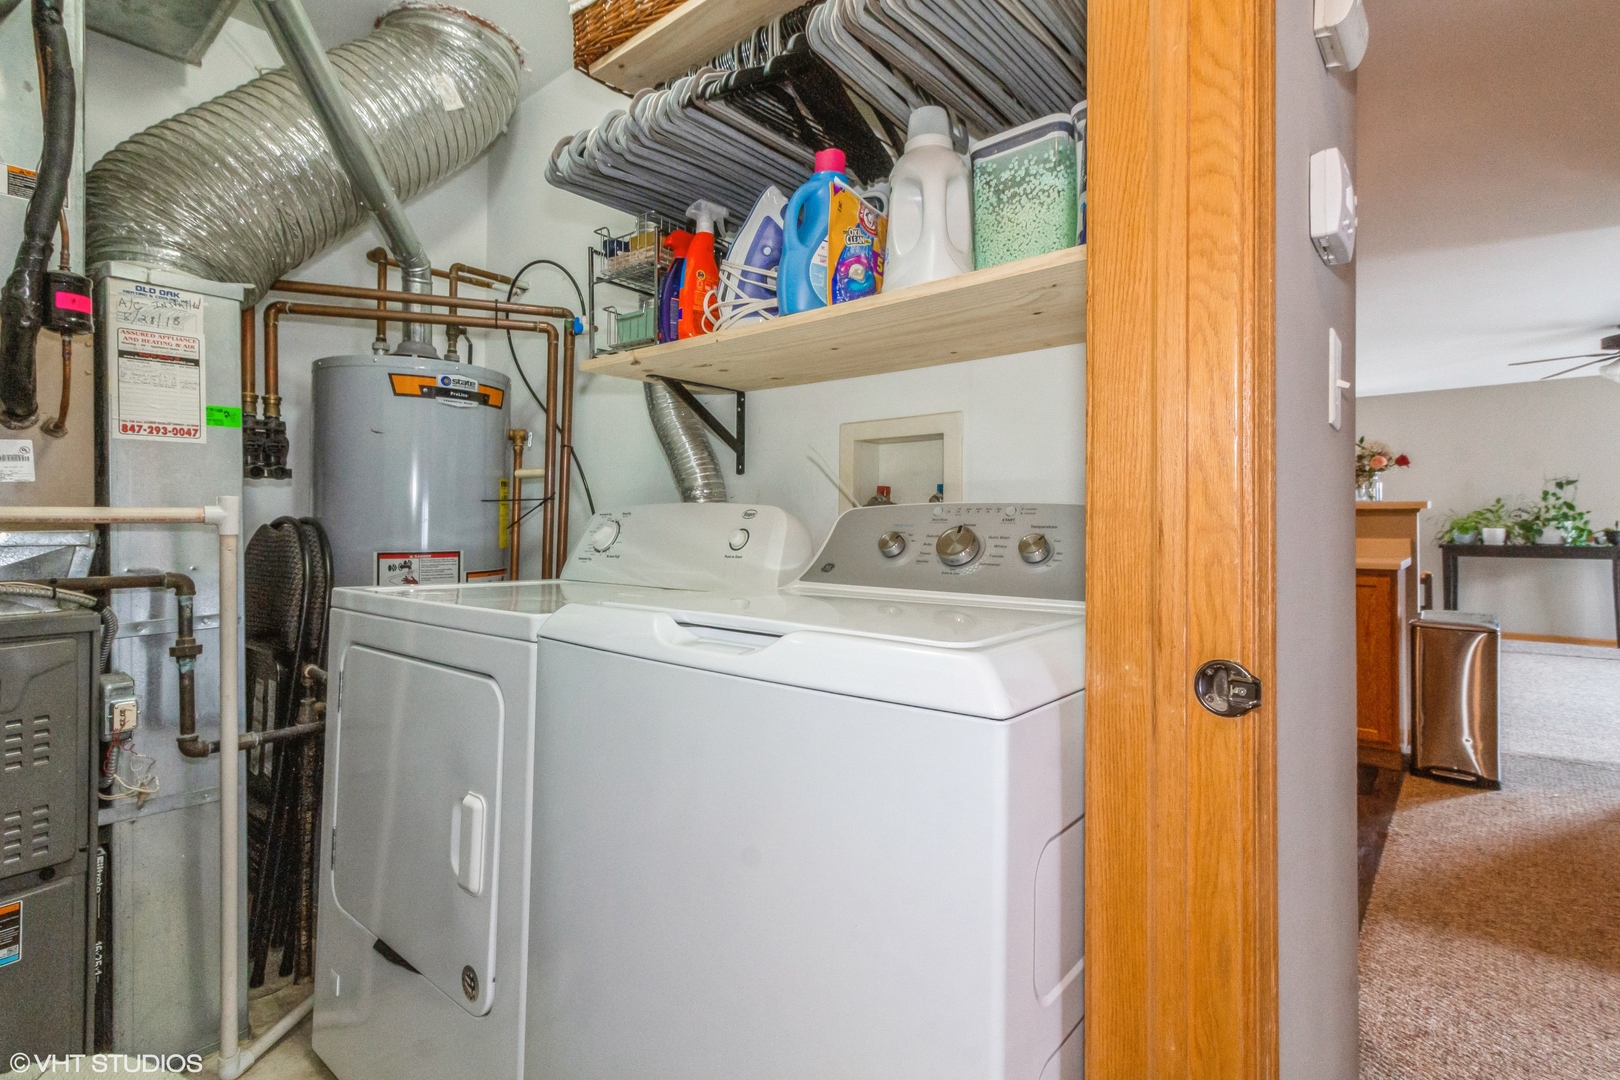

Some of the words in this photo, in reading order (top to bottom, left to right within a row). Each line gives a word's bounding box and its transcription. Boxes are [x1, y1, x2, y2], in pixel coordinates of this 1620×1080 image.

[846, 236, 865, 244] CLEAN
[122, 289, 148, 298] HEATING
[135, 285, 156, 294] OLD
[159, 289, 180, 299] OAK
[121, 329, 156, 338] ASSURED
[157, 333, 197, 344] APPLIANCE
[141, 338, 173, 348] HEATING
[121, 424, 199, 437] 847-293-0047
